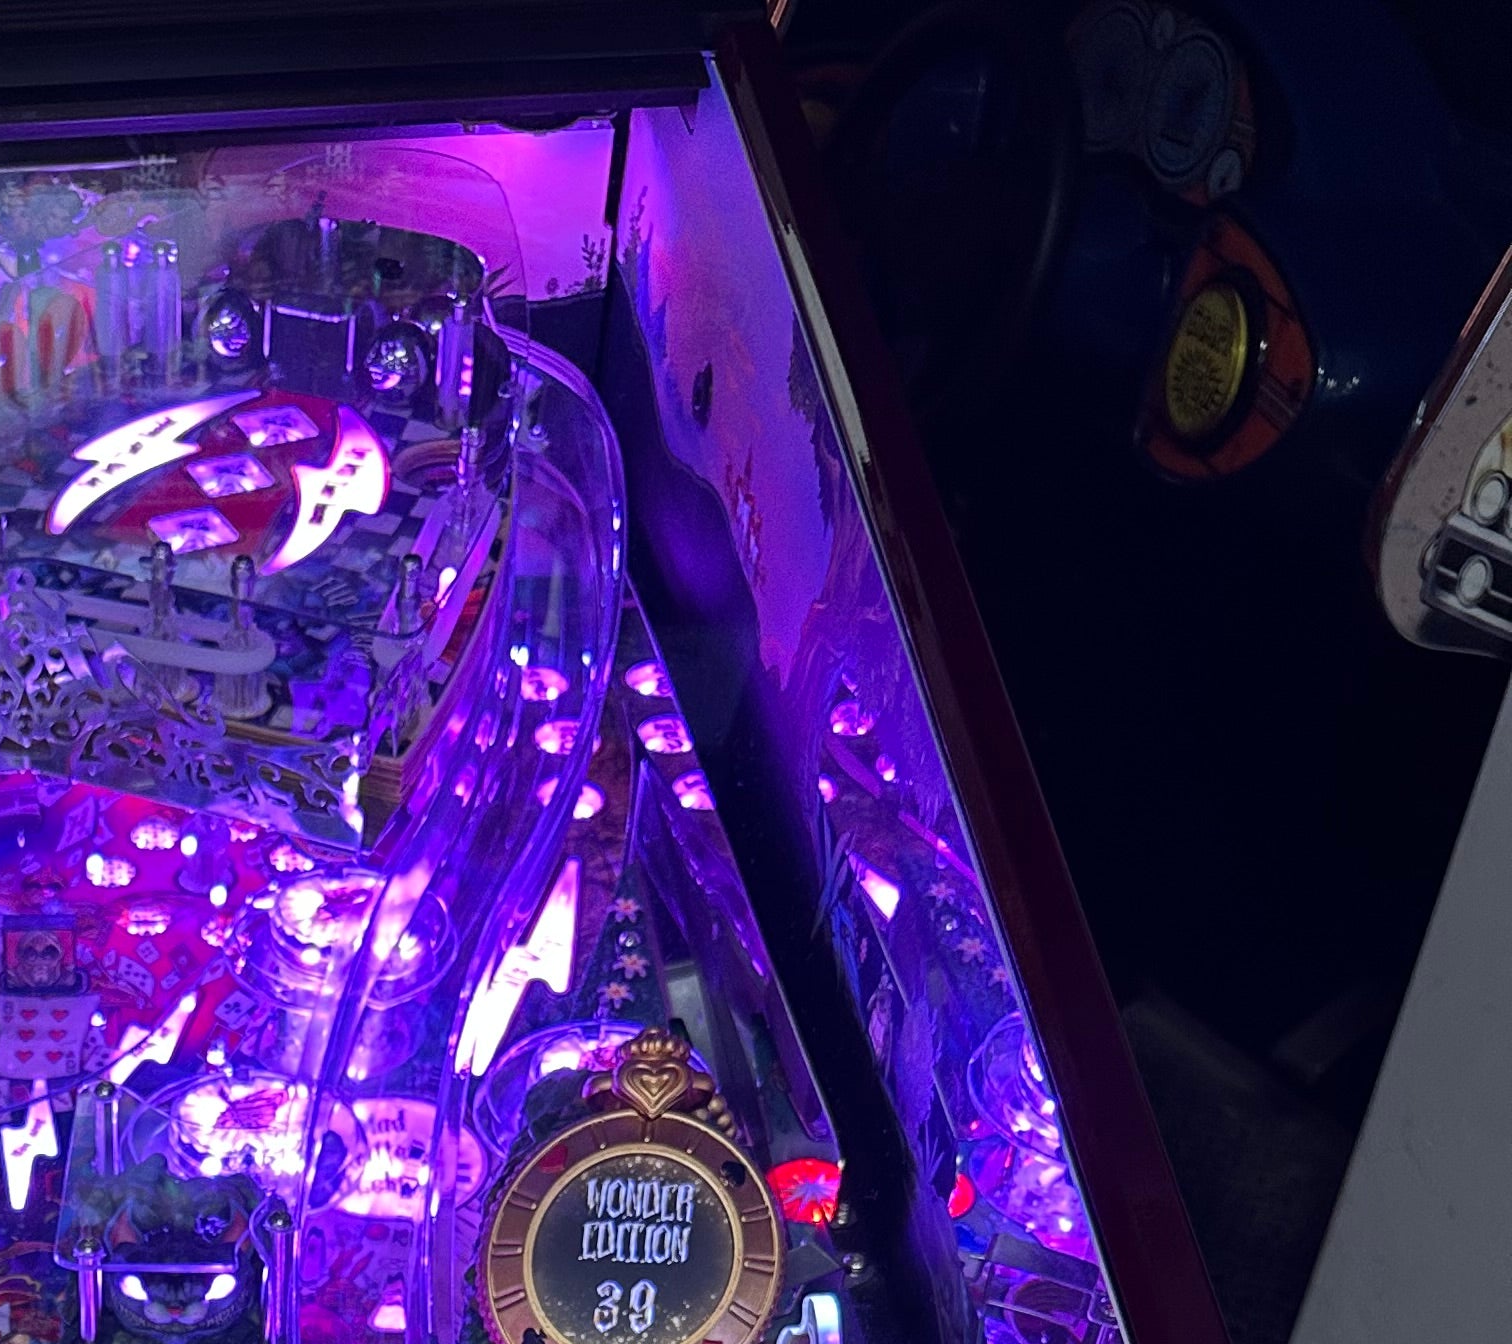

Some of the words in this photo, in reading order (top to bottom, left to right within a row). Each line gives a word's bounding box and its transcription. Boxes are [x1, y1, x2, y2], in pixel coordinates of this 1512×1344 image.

[587, 1177, 695, 1224] WONDER
[577, 1222, 693, 1266] EDITION
[594, 1278, 658, 1335] 39
